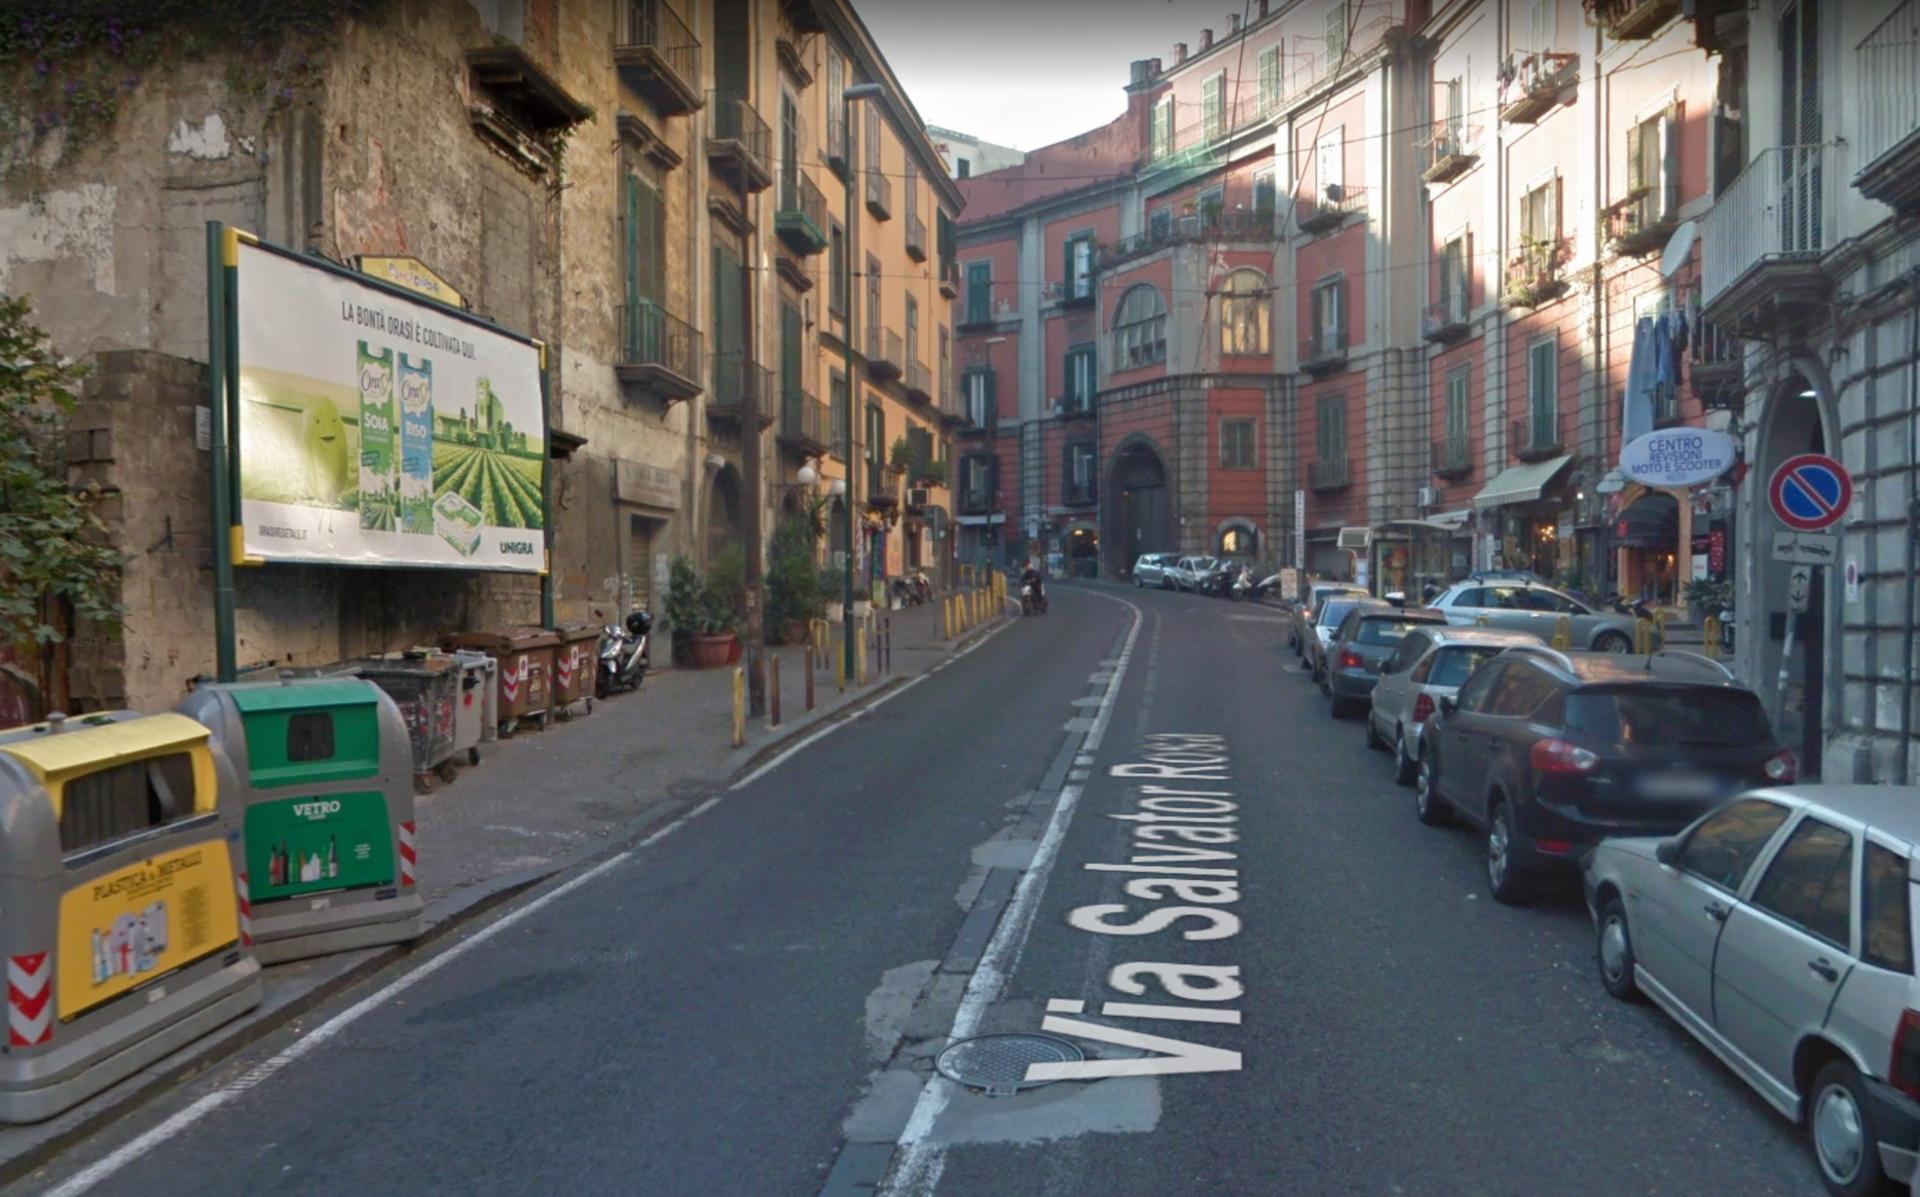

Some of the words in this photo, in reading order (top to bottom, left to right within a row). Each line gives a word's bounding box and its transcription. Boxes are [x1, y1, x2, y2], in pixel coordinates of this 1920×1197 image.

[342, 301, 354, 320] LA
[357, 304, 385, 331] BONTÀ
[388, 316, 413, 340] ORASÌ
[423, 328, 460, 354] COLTIVATA
[364, 412, 389, 432] SOIA
[406, 421, 427, 438] RISO
[1648, 437, 1703, 453] CENTRO
[1649, 450, 1702, 462] REVISIONI
[1632, 463, 1662, 474] MOTO
[1665, 463, 1671, 473] E
[1673, 459, 1722, 472] SCOOTER
[293, 800, 341, 816] VETRO
[93, 871, 146, 901] PLASTICA
[157, 850, 202, 877] METALLI
